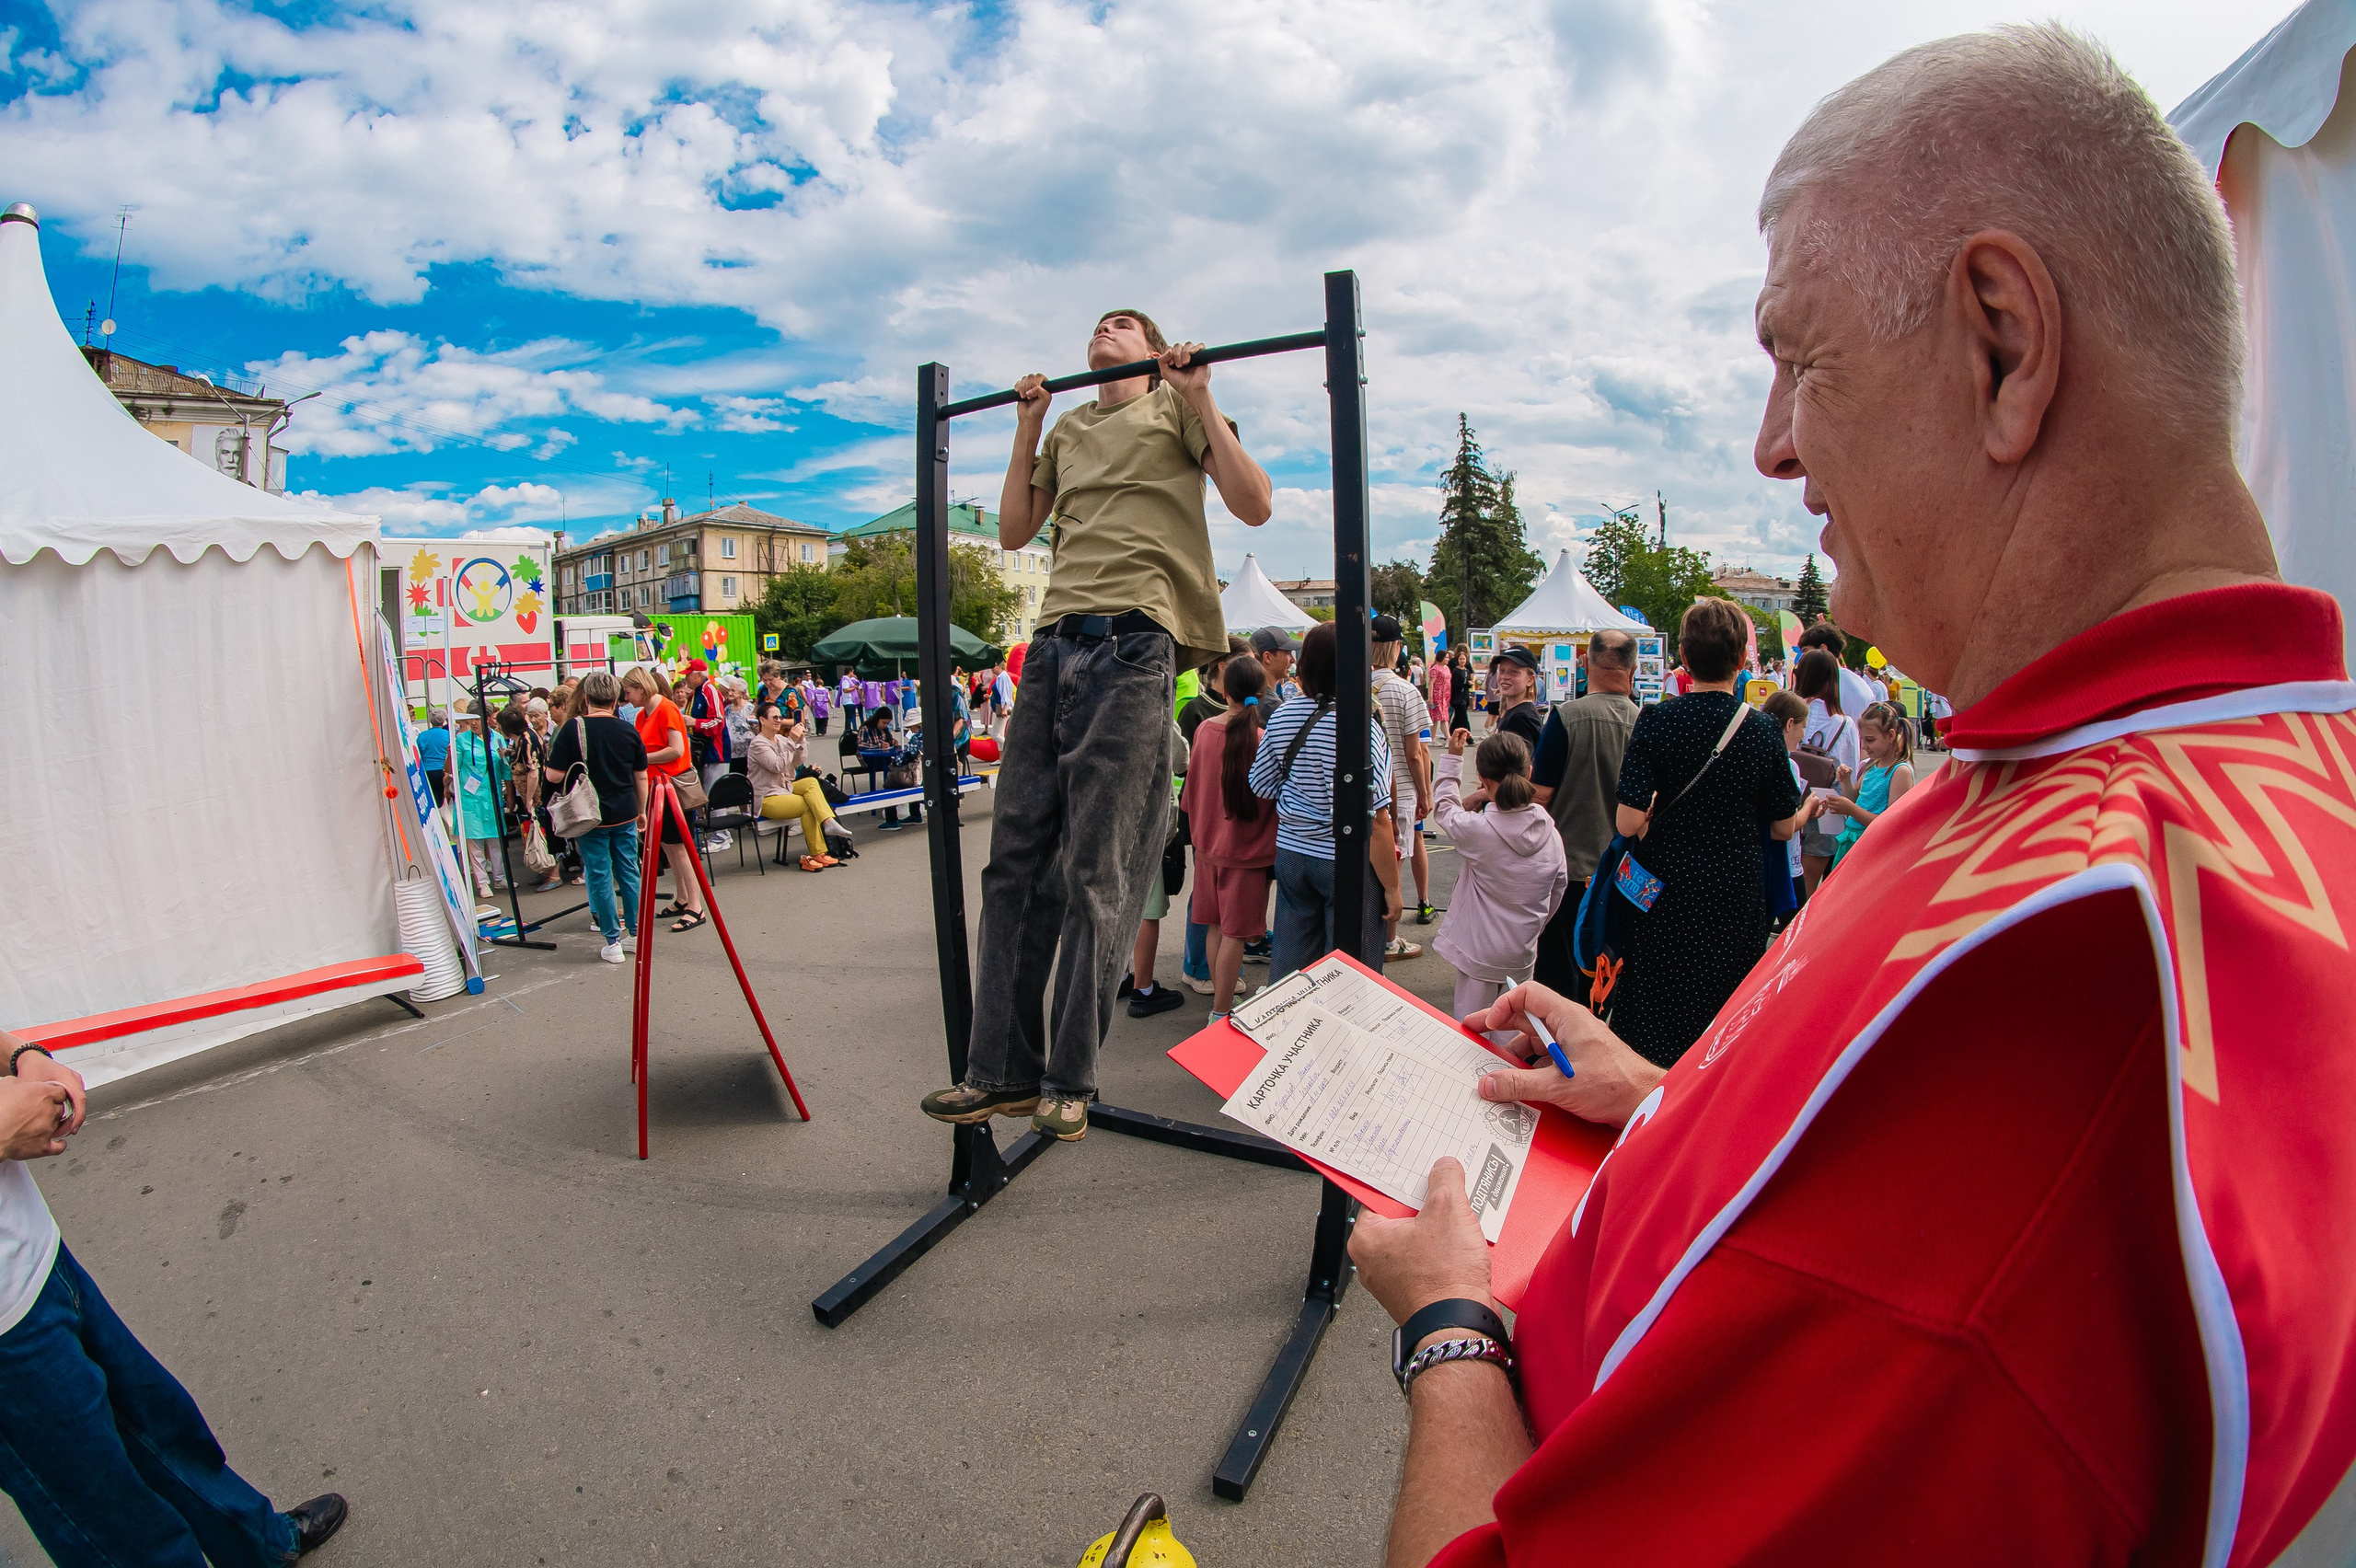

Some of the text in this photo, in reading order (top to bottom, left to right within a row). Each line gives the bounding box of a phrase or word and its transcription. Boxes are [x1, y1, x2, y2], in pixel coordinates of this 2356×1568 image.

[1247, 1064, 1289, 1110] КАРТОЧКА
[1282, 1017, 1323, 1063] УЧАСТНИКА
[1365, 1078, 1378, 1095] Результат
[1265, 1113, 1276, 1124] ФИО:
[1288, 1106, 1312, 1136] Дата рождения:
[1349, 1112, 1358, 1121] Вид
[1299, 1133, 1309, 1142] УИН:
[1311, 1131, 1326, 1147] Телефон:
